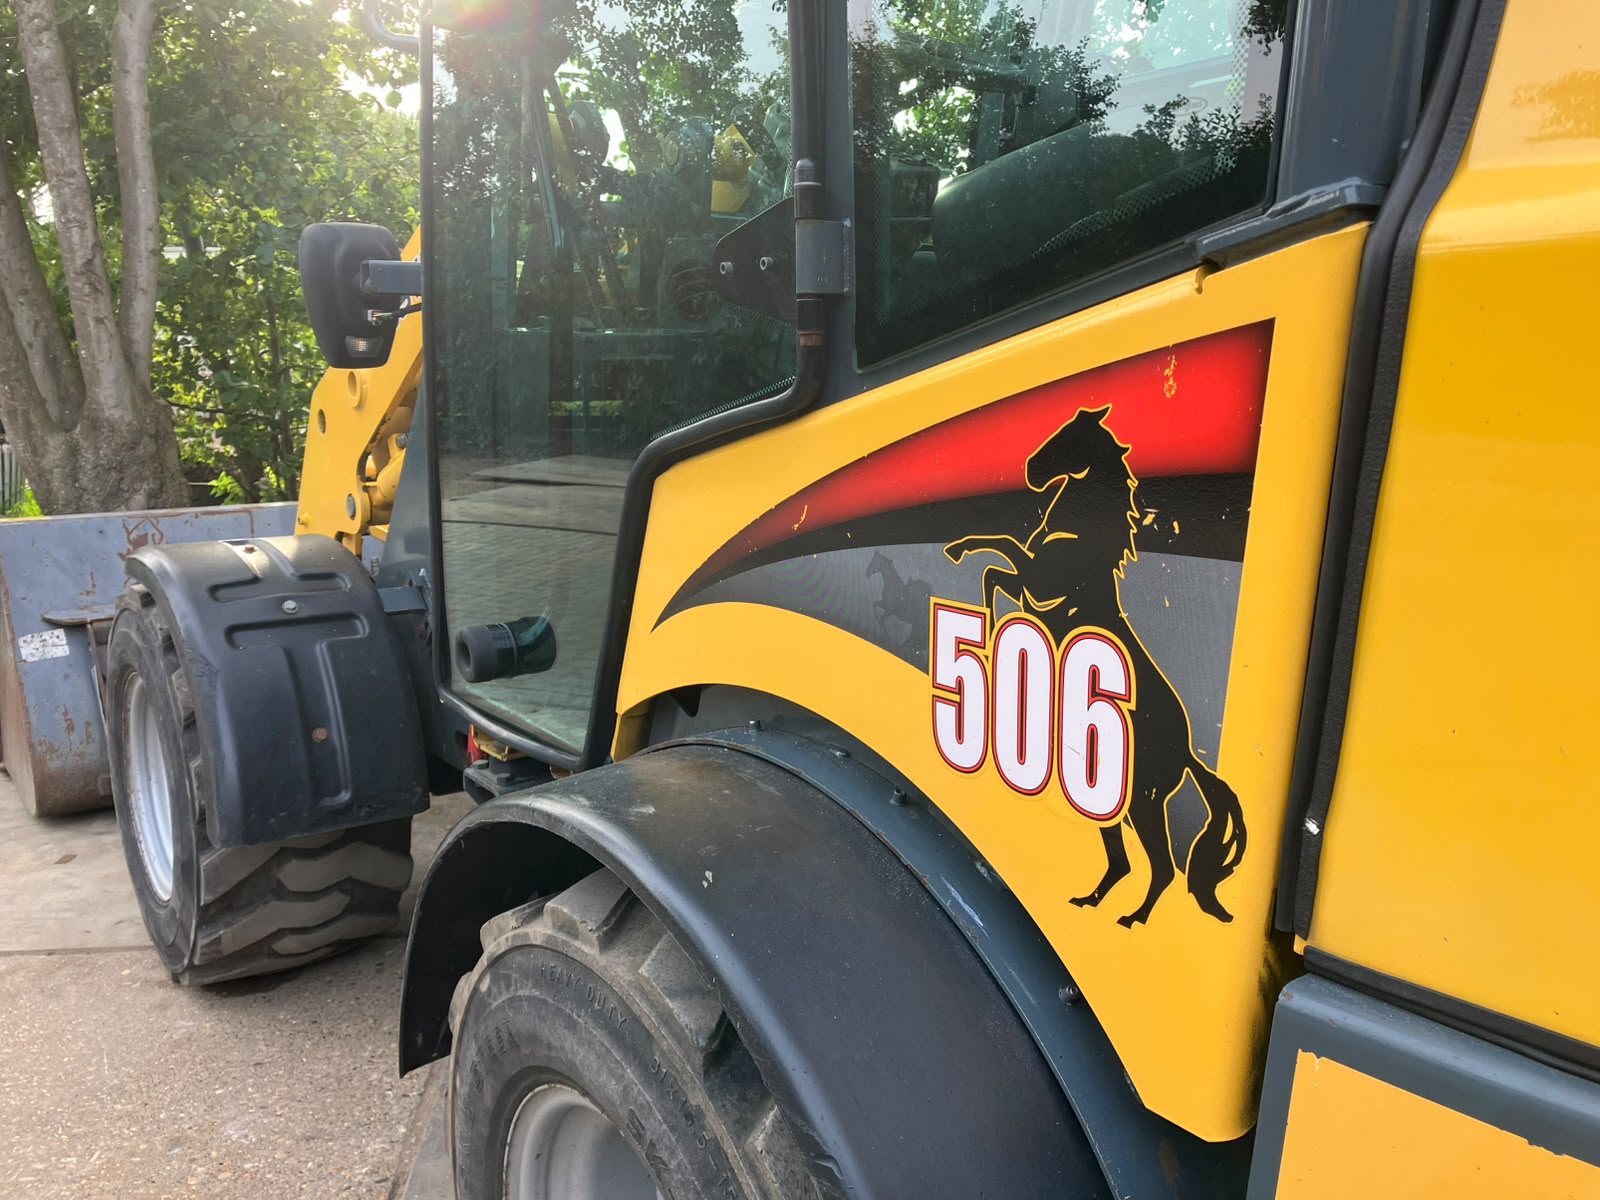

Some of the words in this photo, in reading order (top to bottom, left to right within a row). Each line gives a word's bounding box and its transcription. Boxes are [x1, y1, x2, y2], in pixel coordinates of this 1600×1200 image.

[931, 601, 1134, 823] 506
[540, 961, 582, 992] HEAVY
[585, 984, 628, 1030] DUTY
